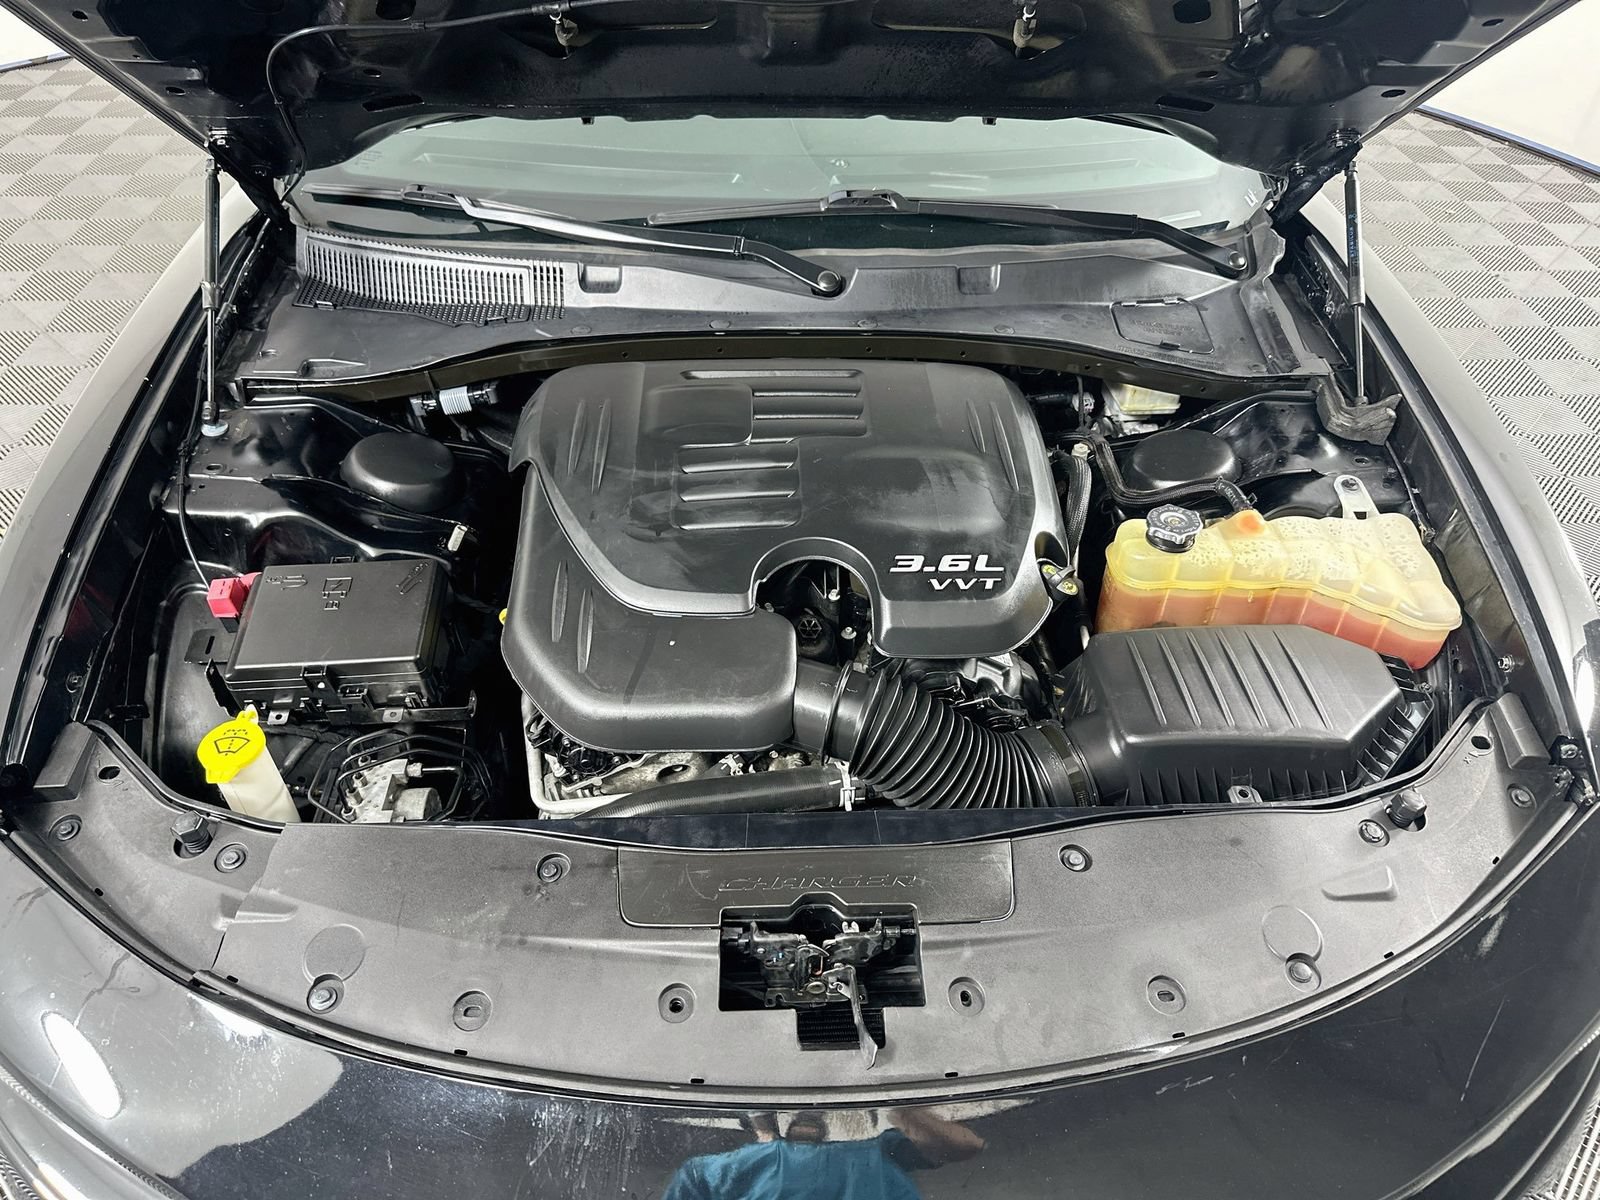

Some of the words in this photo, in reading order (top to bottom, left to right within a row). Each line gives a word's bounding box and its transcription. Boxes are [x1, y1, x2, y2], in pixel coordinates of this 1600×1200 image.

[889, 554, 1005, 574] 3.6L
[928, 578, 1002, 591] VVT
[718, 873, 917, 892] CHARGER
